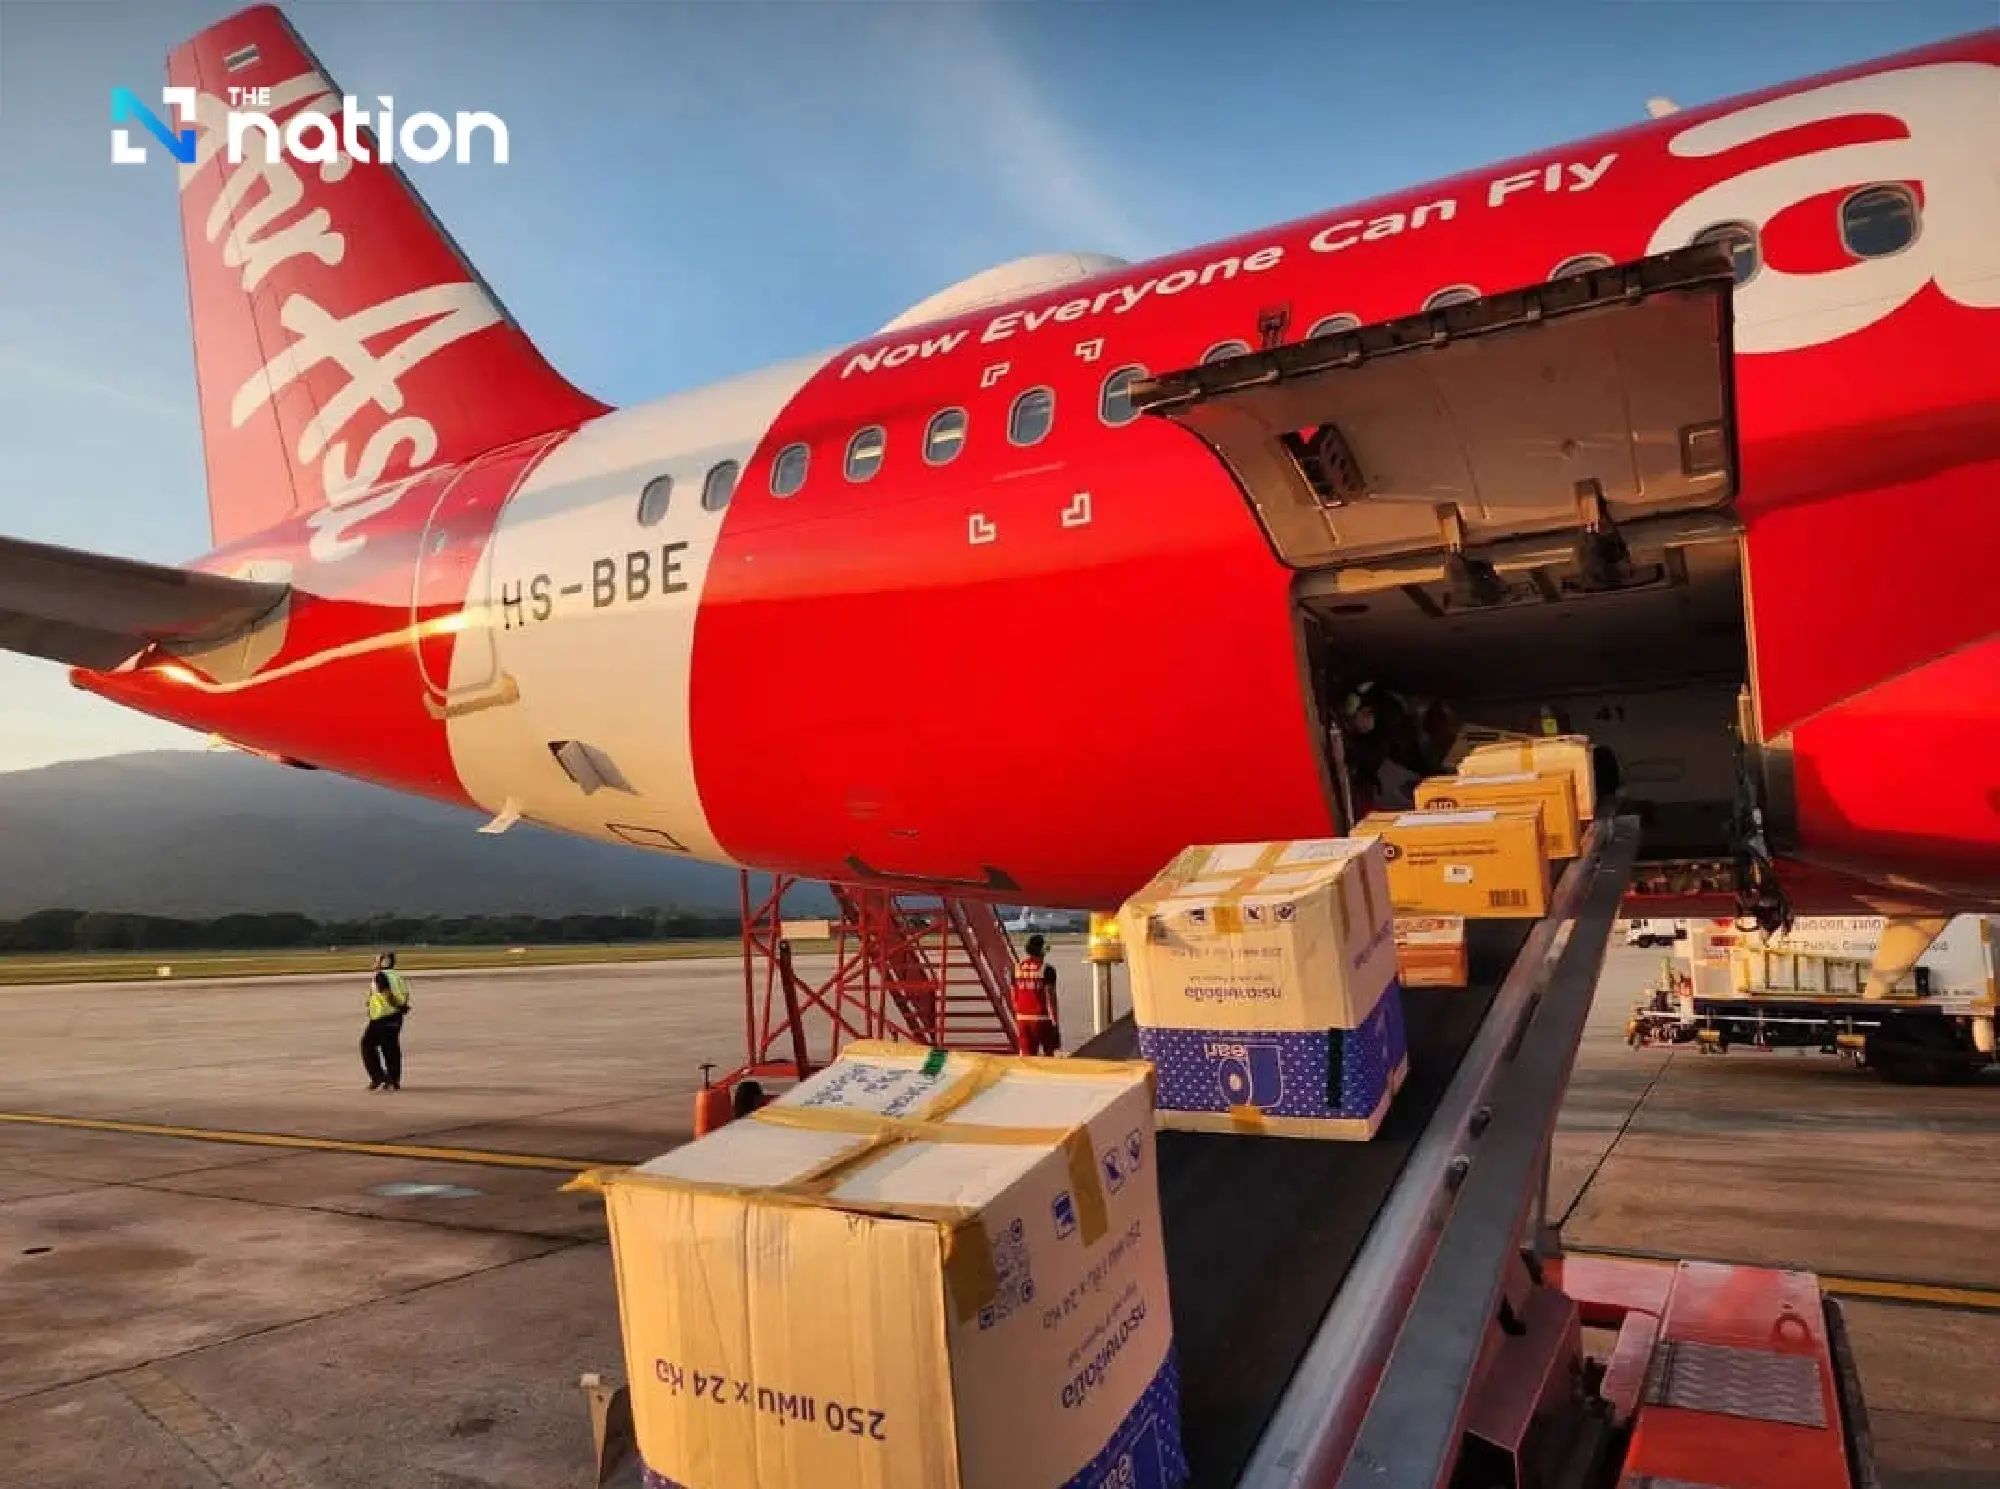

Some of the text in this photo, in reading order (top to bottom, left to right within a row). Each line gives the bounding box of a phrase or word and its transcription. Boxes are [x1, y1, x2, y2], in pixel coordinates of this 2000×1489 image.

[841, 153, 1618, 379] Now Everyone Can Fly
[502, 541, 689, 630] HS-BBE
[654, 1357, 685, 1397] ห่อ
[692, 1369, 726, 1405] 24
[756, 1386, 816, 1428] แผ่น
[825, 1400, 887, 1442] 250
